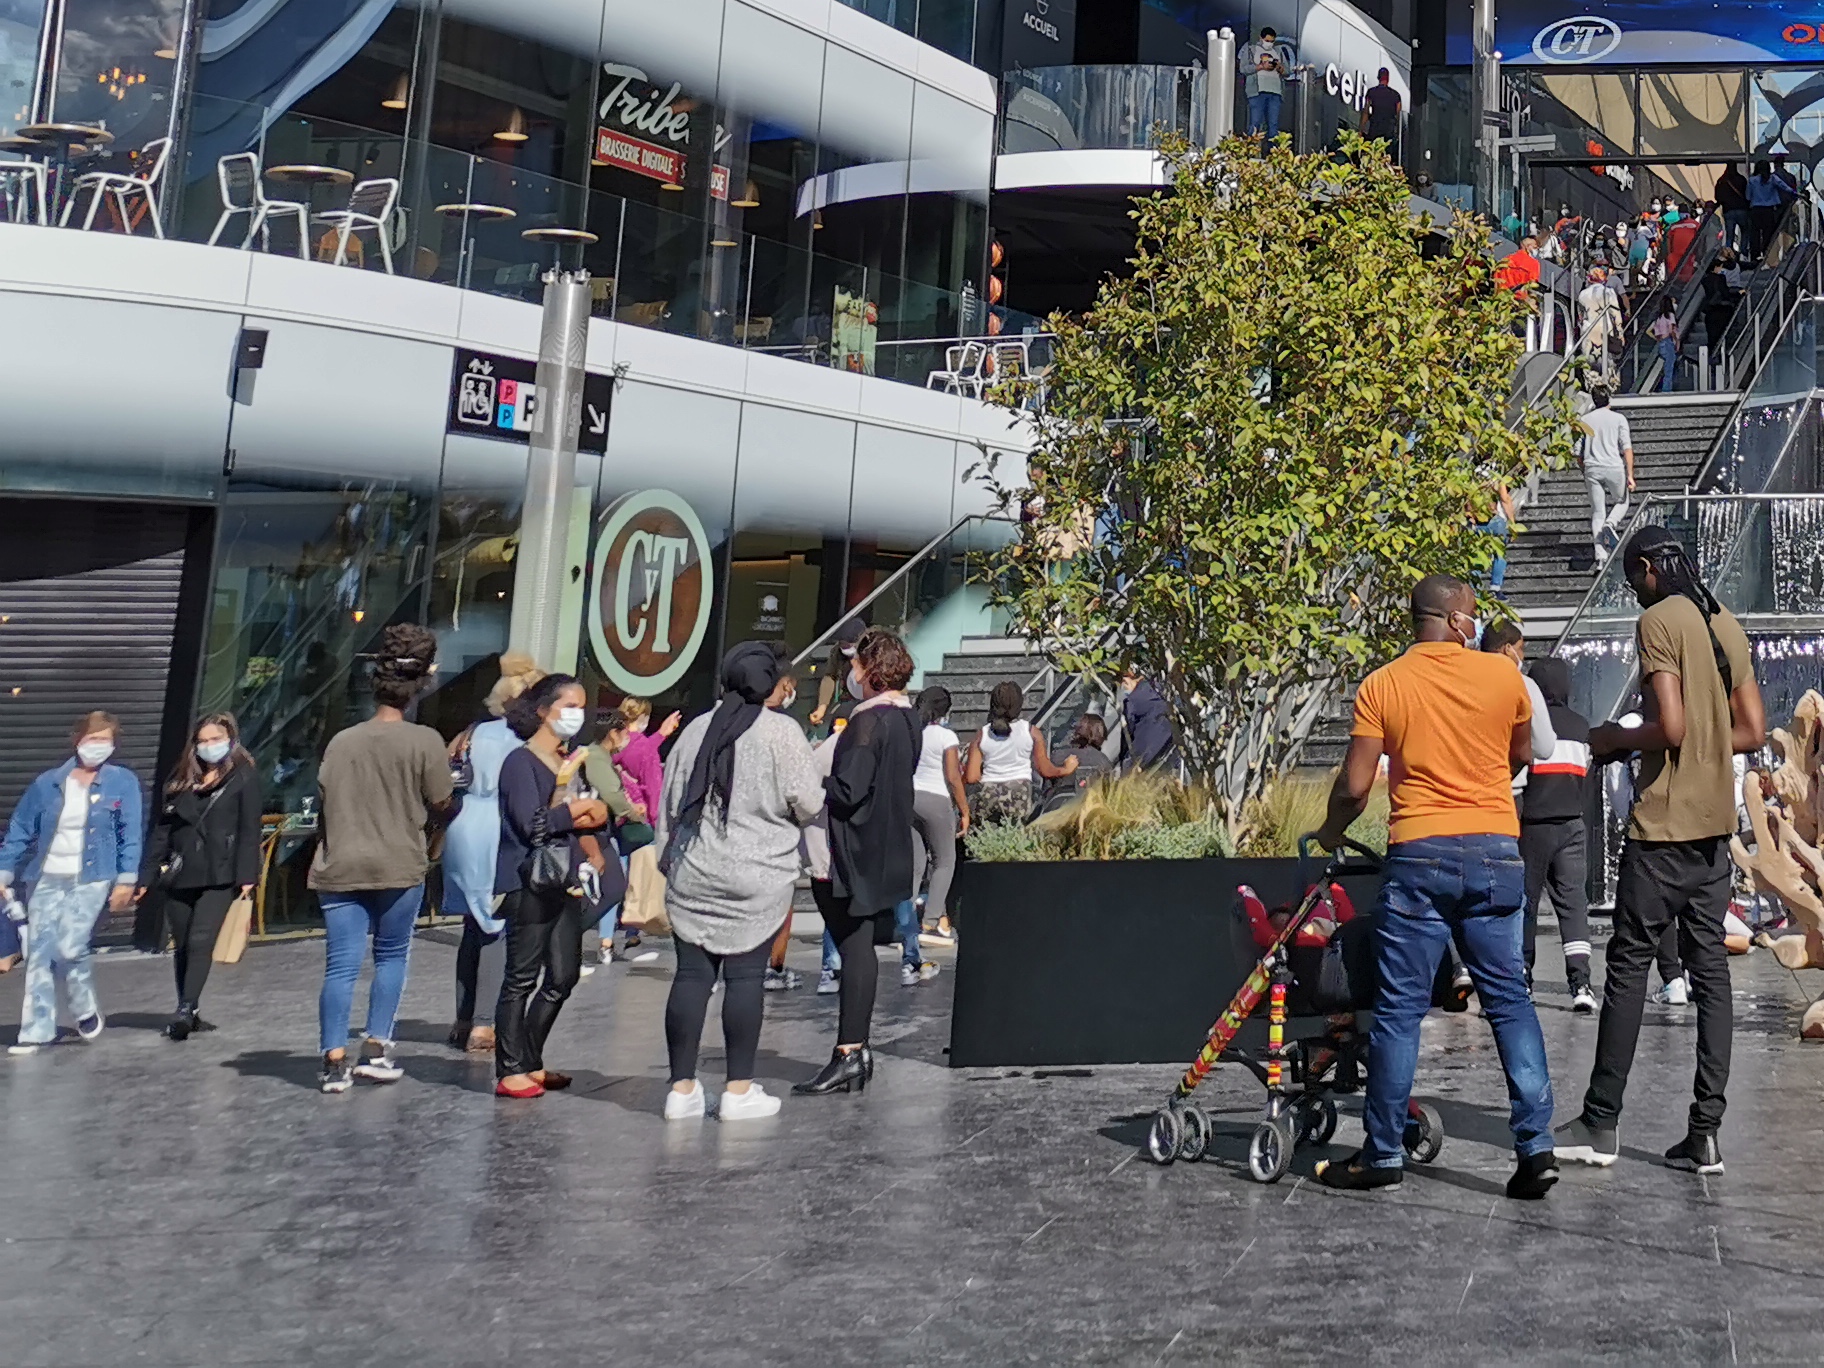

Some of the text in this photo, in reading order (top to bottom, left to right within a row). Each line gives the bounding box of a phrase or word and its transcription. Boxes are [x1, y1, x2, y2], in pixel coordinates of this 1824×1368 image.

[1023, 12, 1060, 42] ACCUEIL
[1325, 62, 1373, 115] celi
[600, 135, 640, 165] BRASSERIE
[641, 149, 674, 176] DIGITALE
